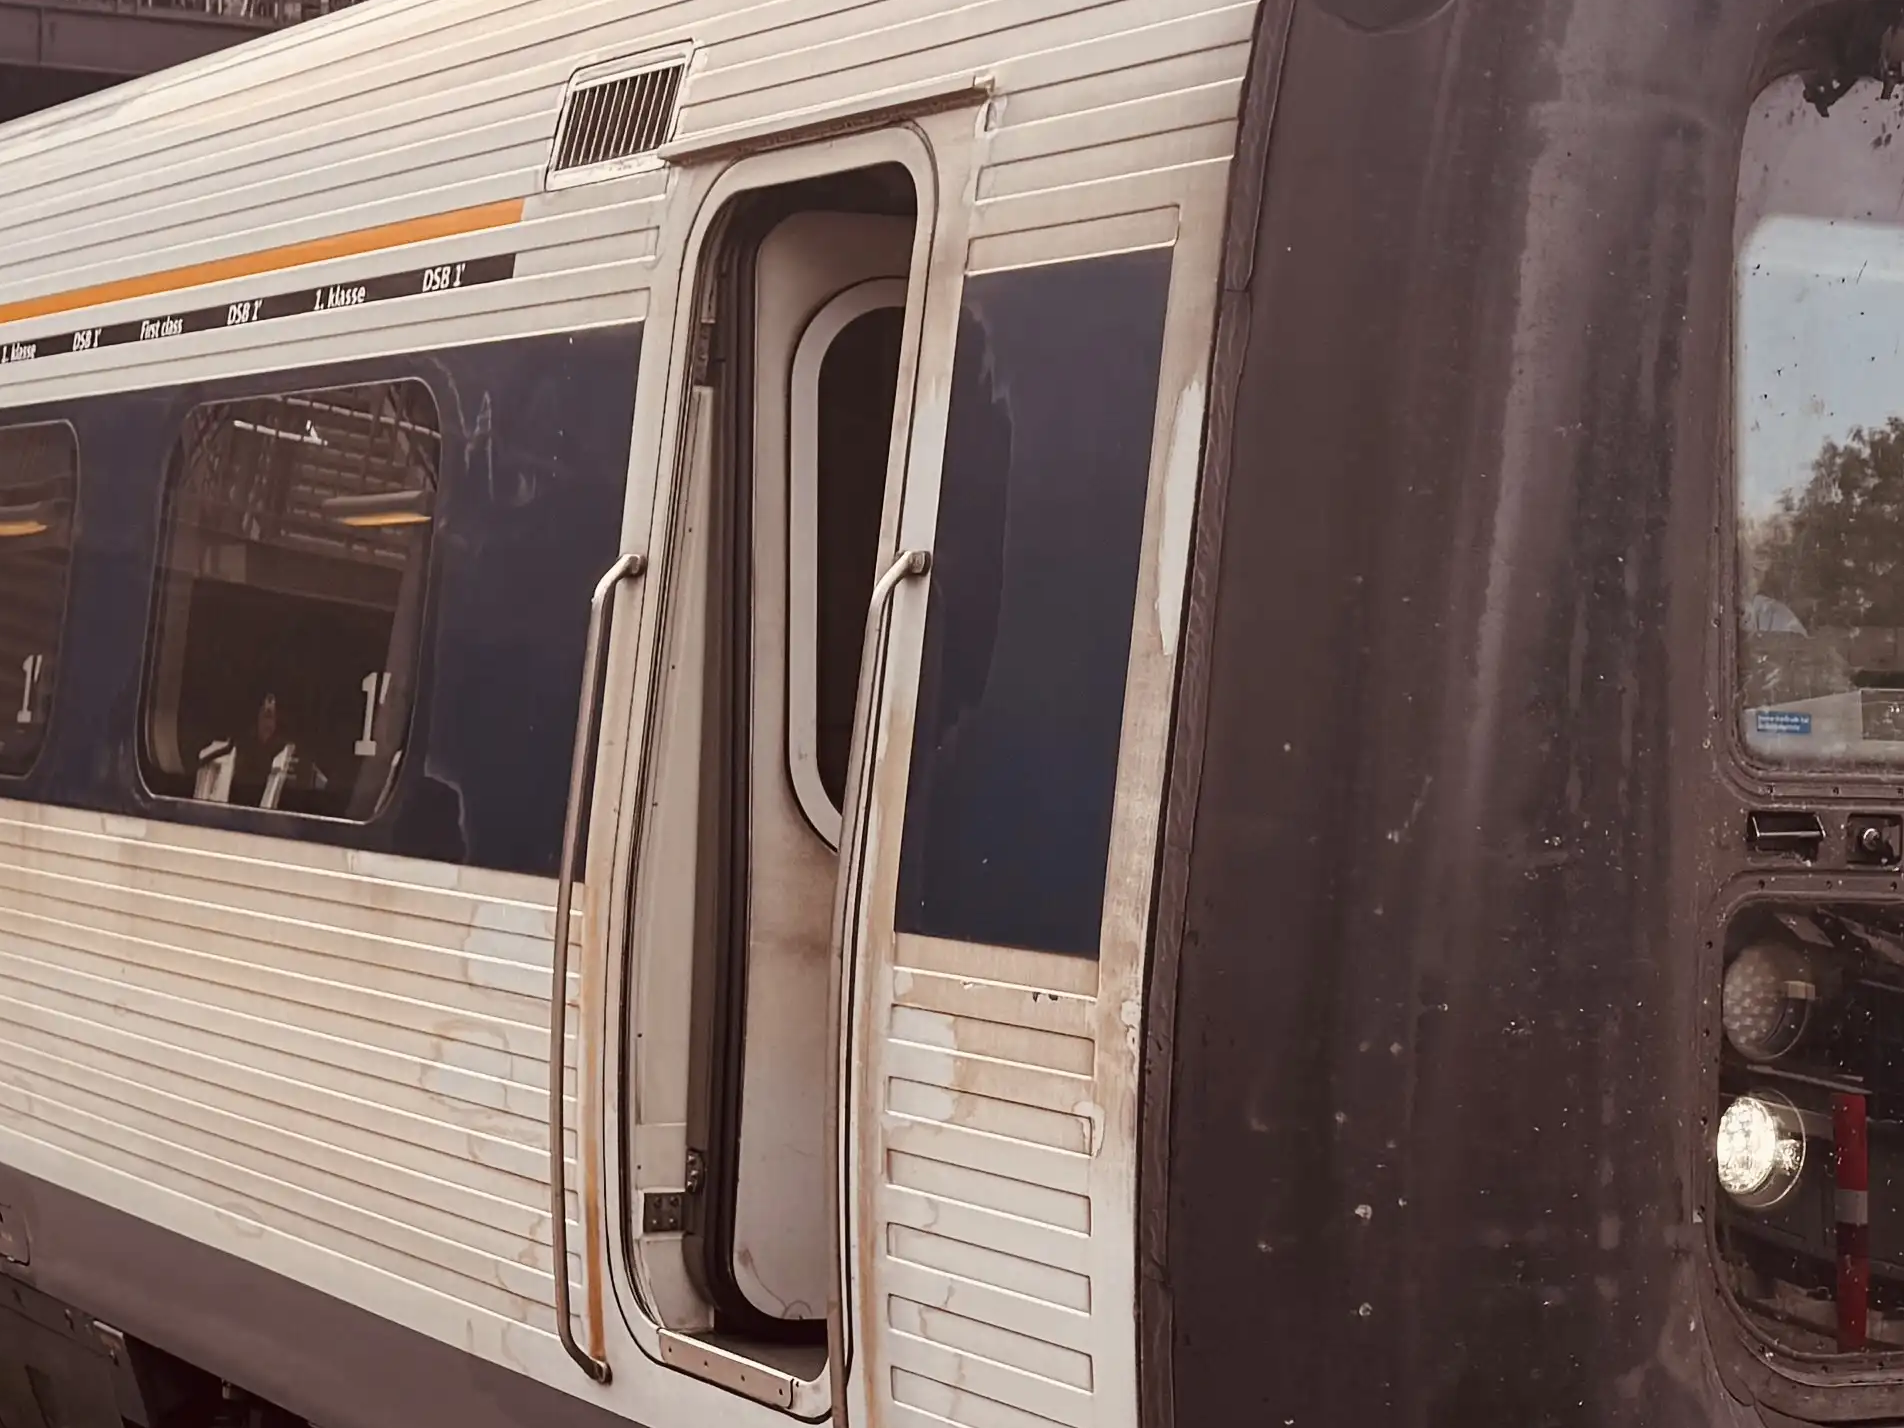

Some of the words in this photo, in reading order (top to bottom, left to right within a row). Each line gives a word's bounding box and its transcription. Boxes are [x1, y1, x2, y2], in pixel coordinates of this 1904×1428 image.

[72, 329, 92, 351] DSB
[140, 319, 159, 341] First
[160, 316, 183, 337] class
[226, 301, 250, 326] DSB
[314, 288, 325, 312] 1.
[327, 285, 367, 308] klasse
[421, 265, 450, 292] DSB
